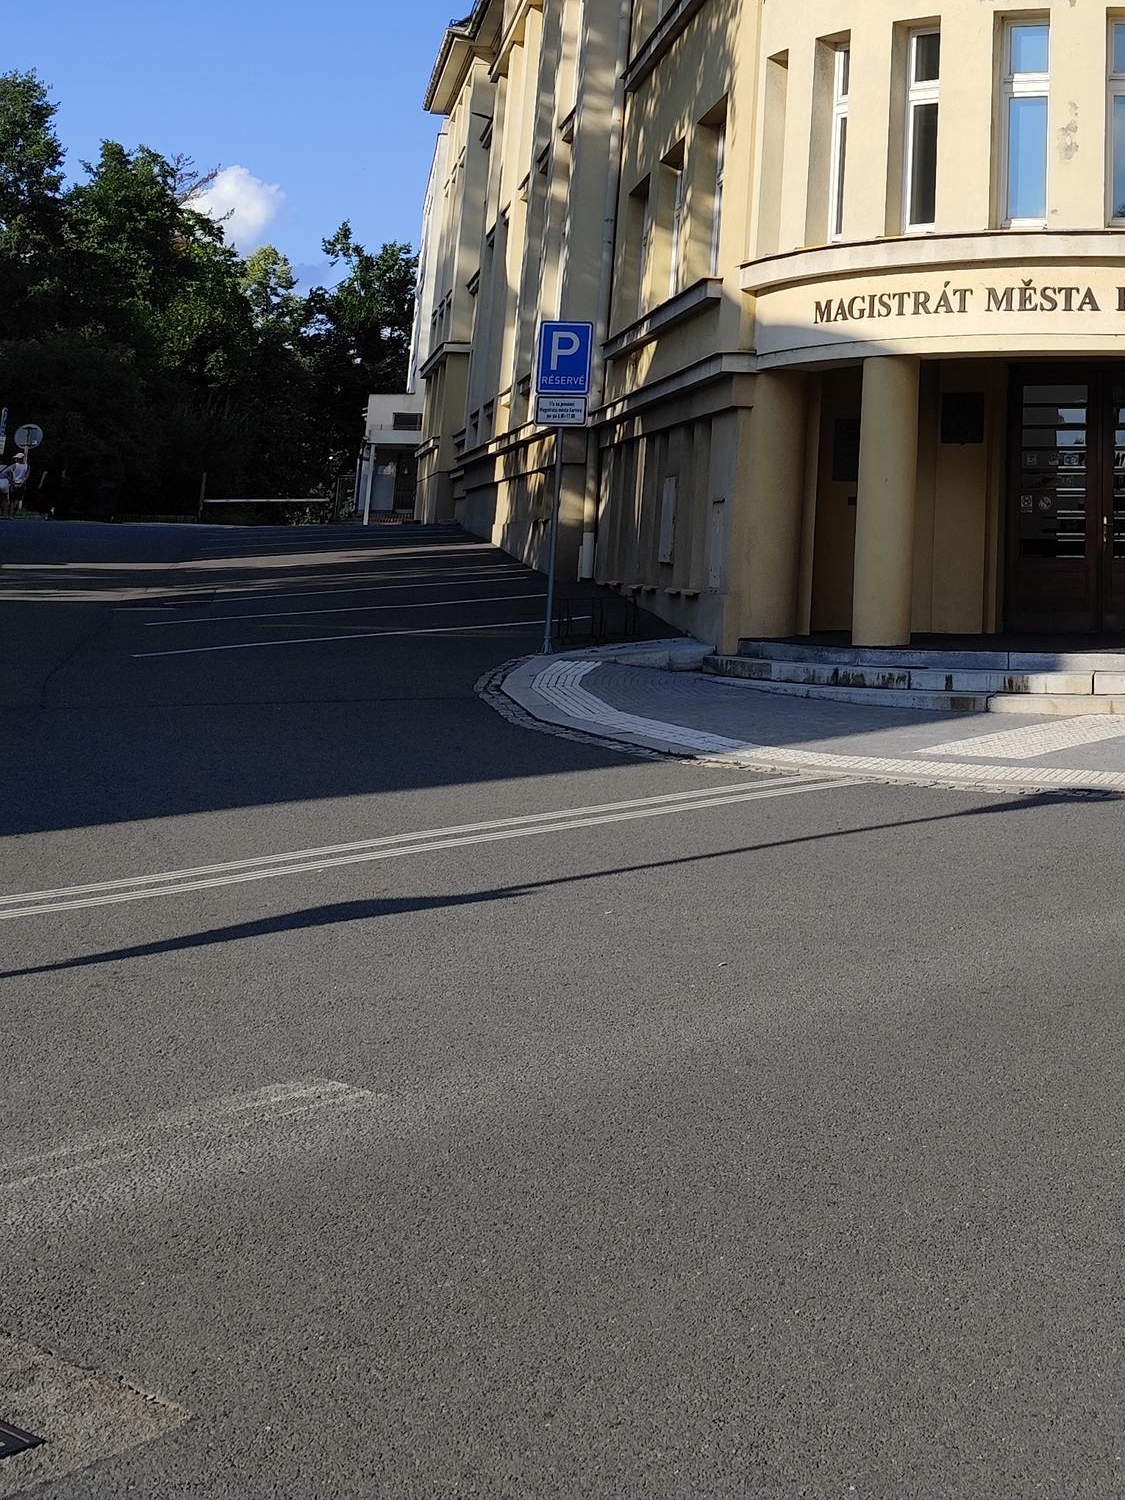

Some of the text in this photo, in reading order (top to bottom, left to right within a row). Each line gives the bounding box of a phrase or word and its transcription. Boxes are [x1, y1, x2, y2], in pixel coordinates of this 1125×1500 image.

[813, 281, 973, 324] MAGISTRÁT
[985, 278, 1101, 312] MĚSTA
[550, 331, 580, 370] P
[541, 375, 585, 385] RÉSERVÉ
